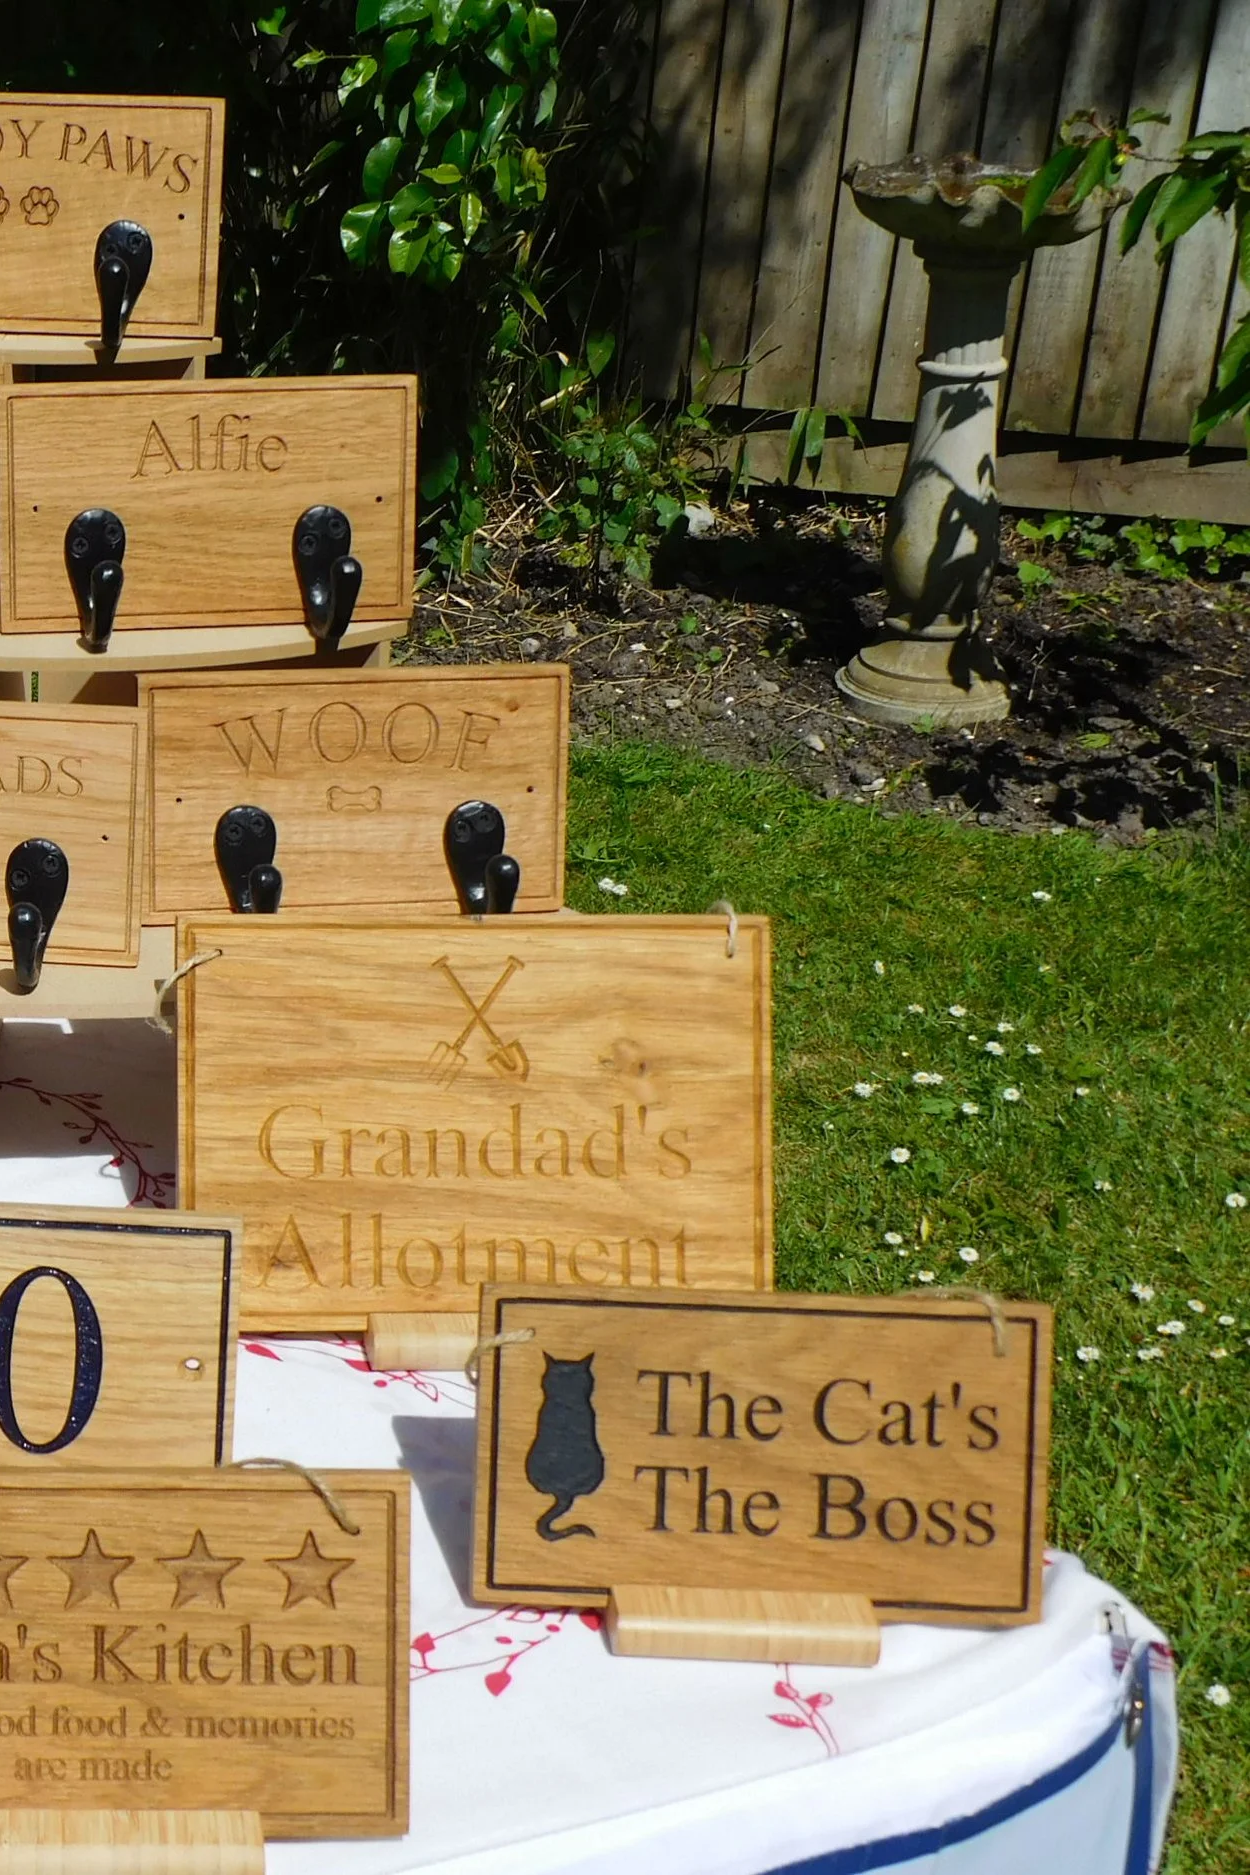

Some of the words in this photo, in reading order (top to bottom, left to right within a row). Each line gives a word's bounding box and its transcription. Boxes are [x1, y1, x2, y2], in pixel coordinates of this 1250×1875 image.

[55, 123, 200, 194] PAWS
[129, 413, 289, 479] Alfie
[211, 701, 501, 775] WOOF
[257, 1102, 693, 1180] Grandad's
[252, 1212, 696, 1288] Allotment
[637, 1369, 784, 1442] The
[813, 1377, 1001, 1451] Cat's
[634, 1465, 780, 1537] The
[809, 1472, 996, 1547] Boss
[90, 1624, 360, 1686] Kitchen
[51, 1705, 127, 1739] food
[139, 1708, 172, 1738] &
[184, 1708, 357, 1739] memories
[14, 1755, 65, 1781] are
[79, 1750, 174, 1782] made
